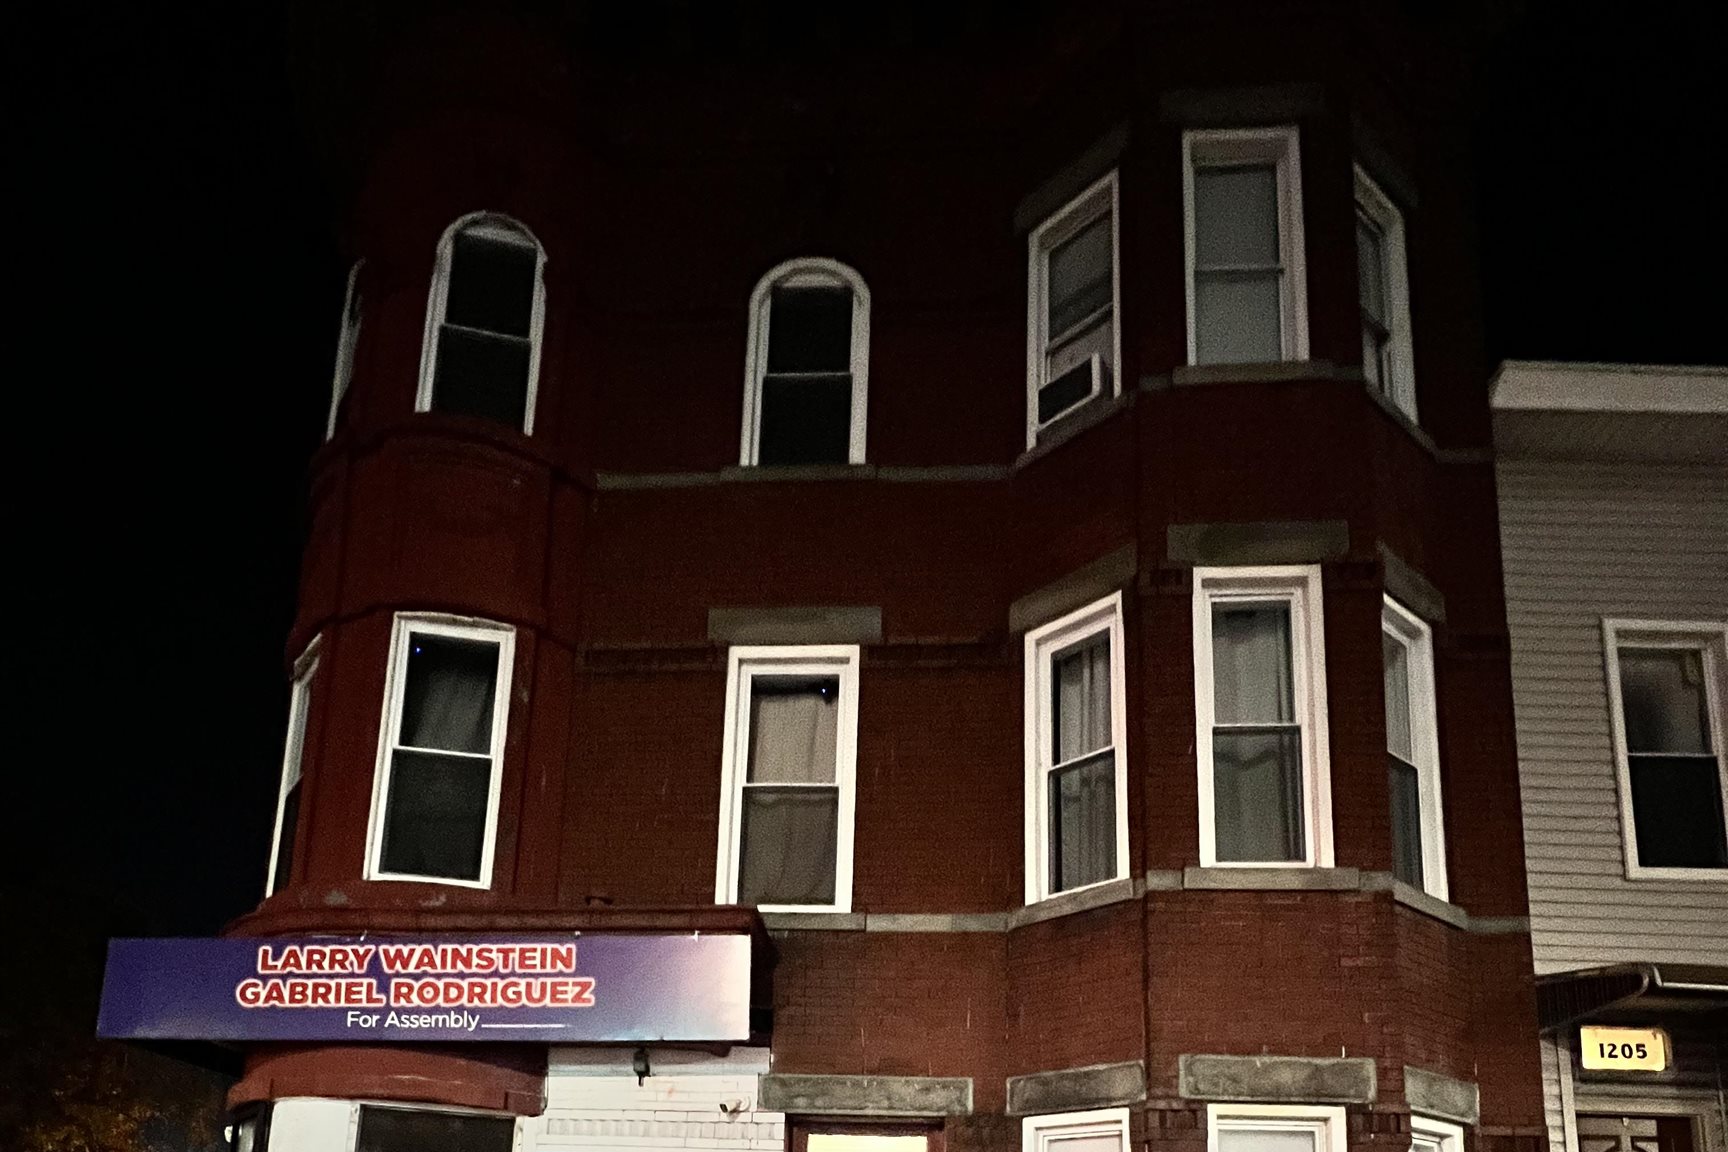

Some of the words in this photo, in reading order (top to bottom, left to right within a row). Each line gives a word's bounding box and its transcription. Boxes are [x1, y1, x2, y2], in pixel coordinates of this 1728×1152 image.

[258, 945, 374, 973] LARRY
[382, 945, 577, 973] WAINSTEIN
[236, 978, 385, 1007] GABRIEL
[391, 978, 595, 1007] RODRIGUEZ
[347, 1012, 378, 1028] For
[384, 1011, 480, 1031] Assembly
[1599, 1043, 1648, 1059] 1205
